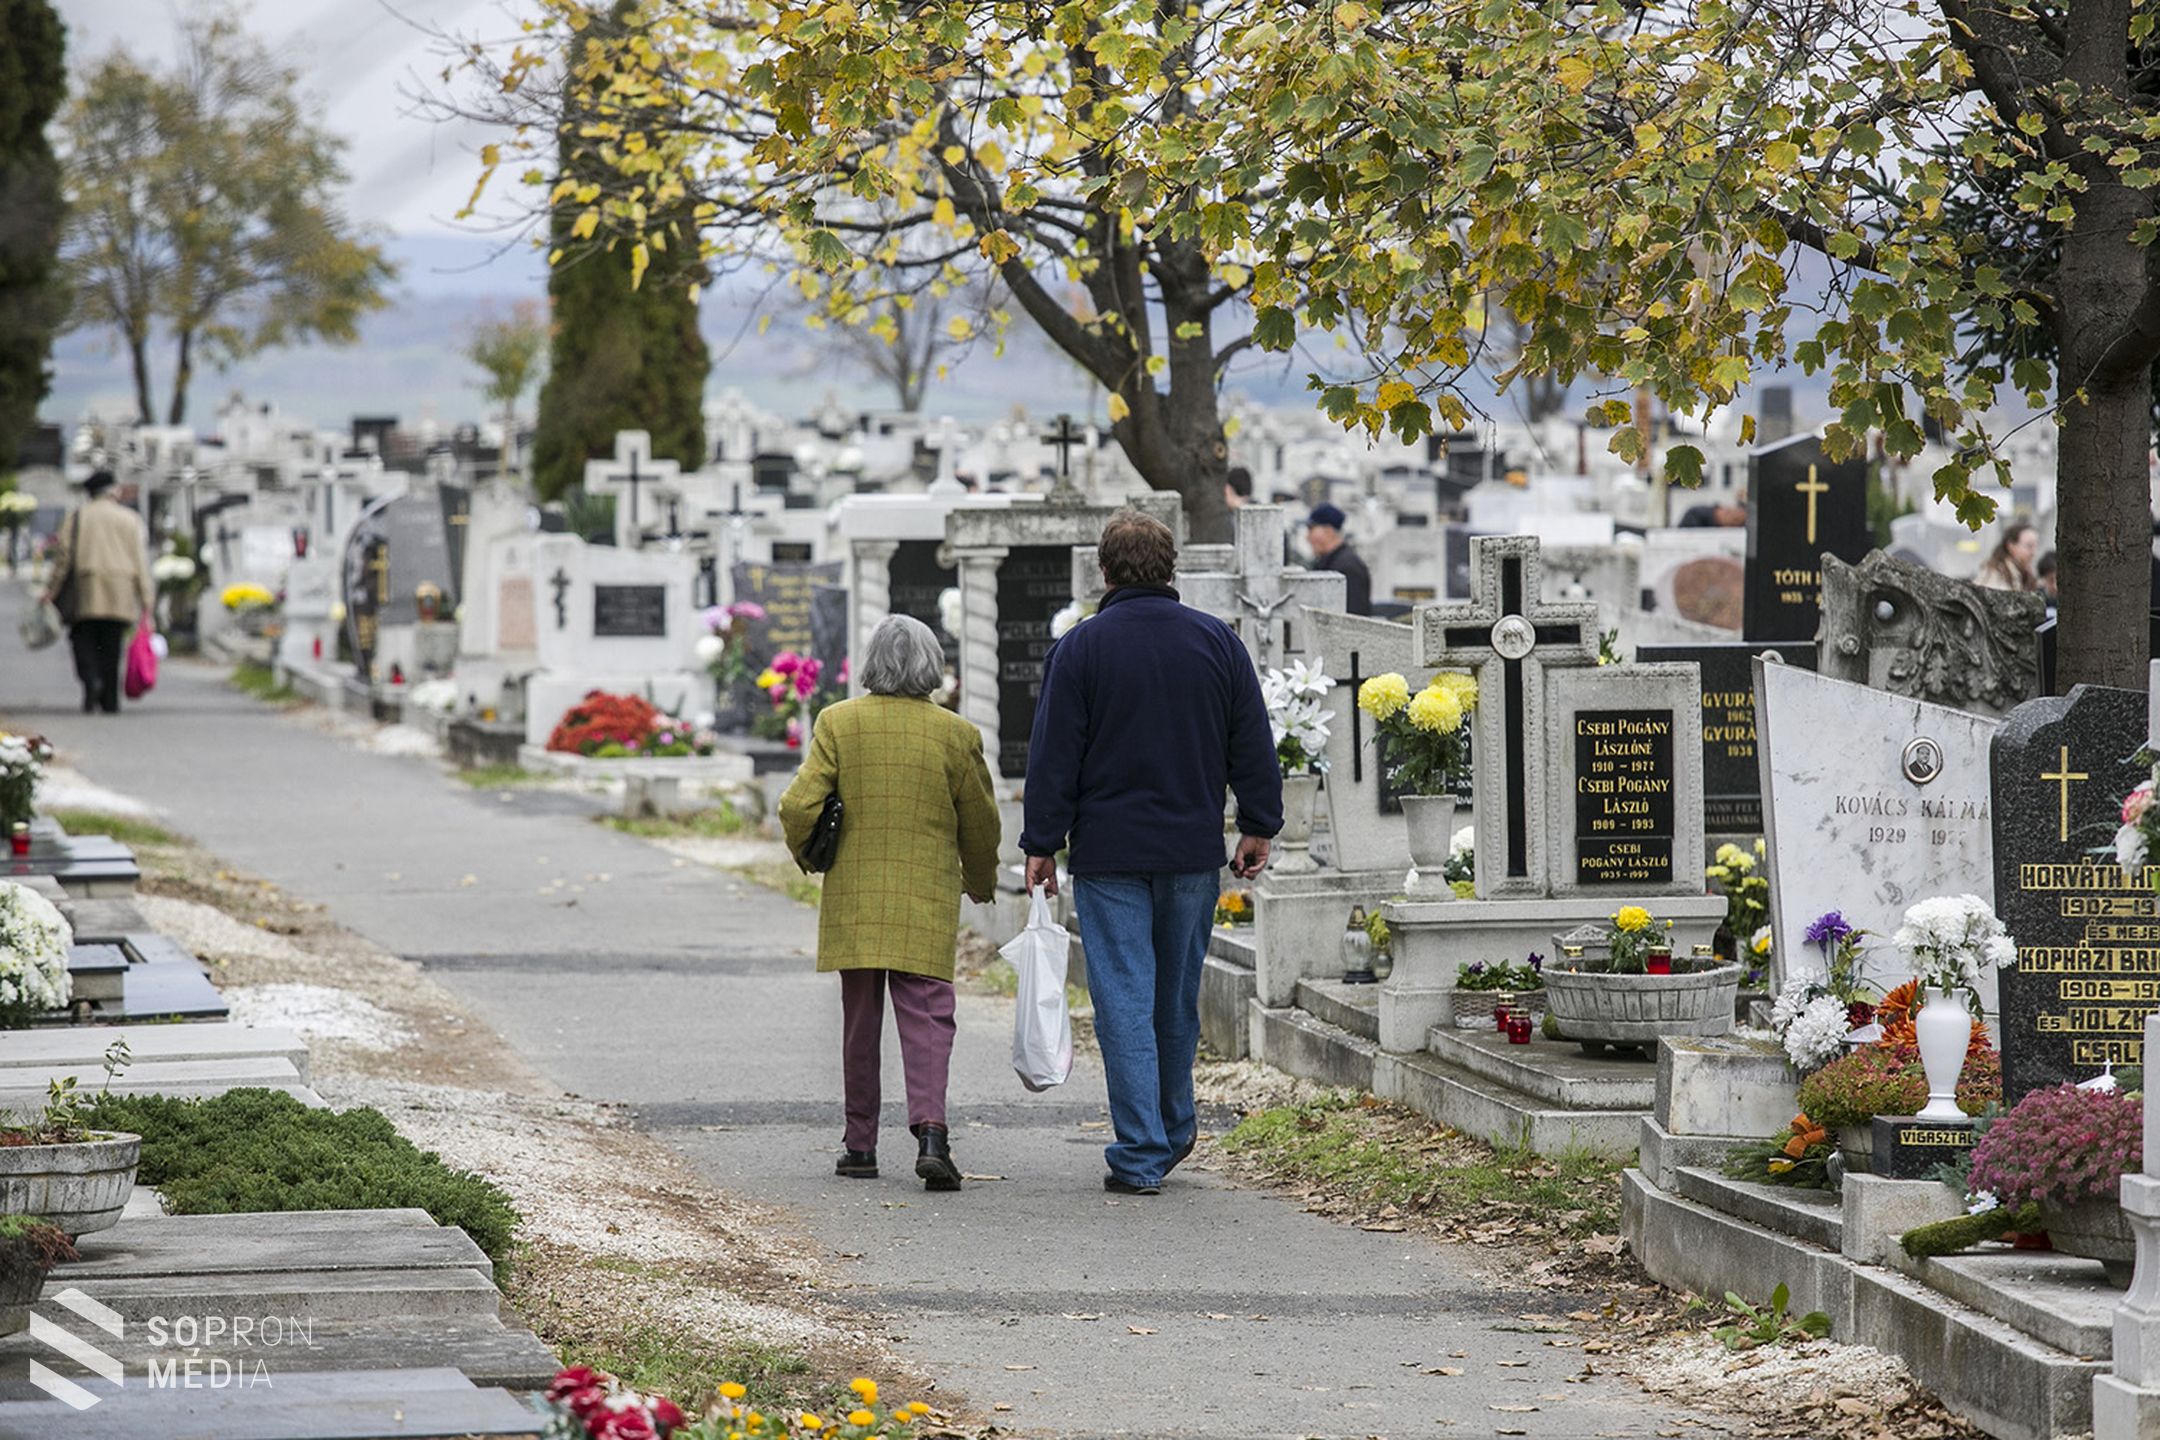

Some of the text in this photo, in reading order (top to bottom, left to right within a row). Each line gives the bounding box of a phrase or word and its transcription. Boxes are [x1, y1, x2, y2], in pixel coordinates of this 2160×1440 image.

[1773, 569, 1812, 586] TÓTH
[1595, 738, 1653, 756] LÁSZLÓNÉ
[1592, 761, 1614, 773] 1910
[1603, 797, 1649, 814] LÁSZLÓ
[1835, 791, 1909, 817] KOVÁCS
[1631, 818, 1655, 830] 1993
[1869, 826, 1907, 844] 1929
[1608, 843, 1641, 855] CSEBI
[2021, 857, 2122, 889] HORVÁTH
[2019, 940, 2114, 972] KOPHÁZI
[2075, 1041, 2144, 1064] CSAL
